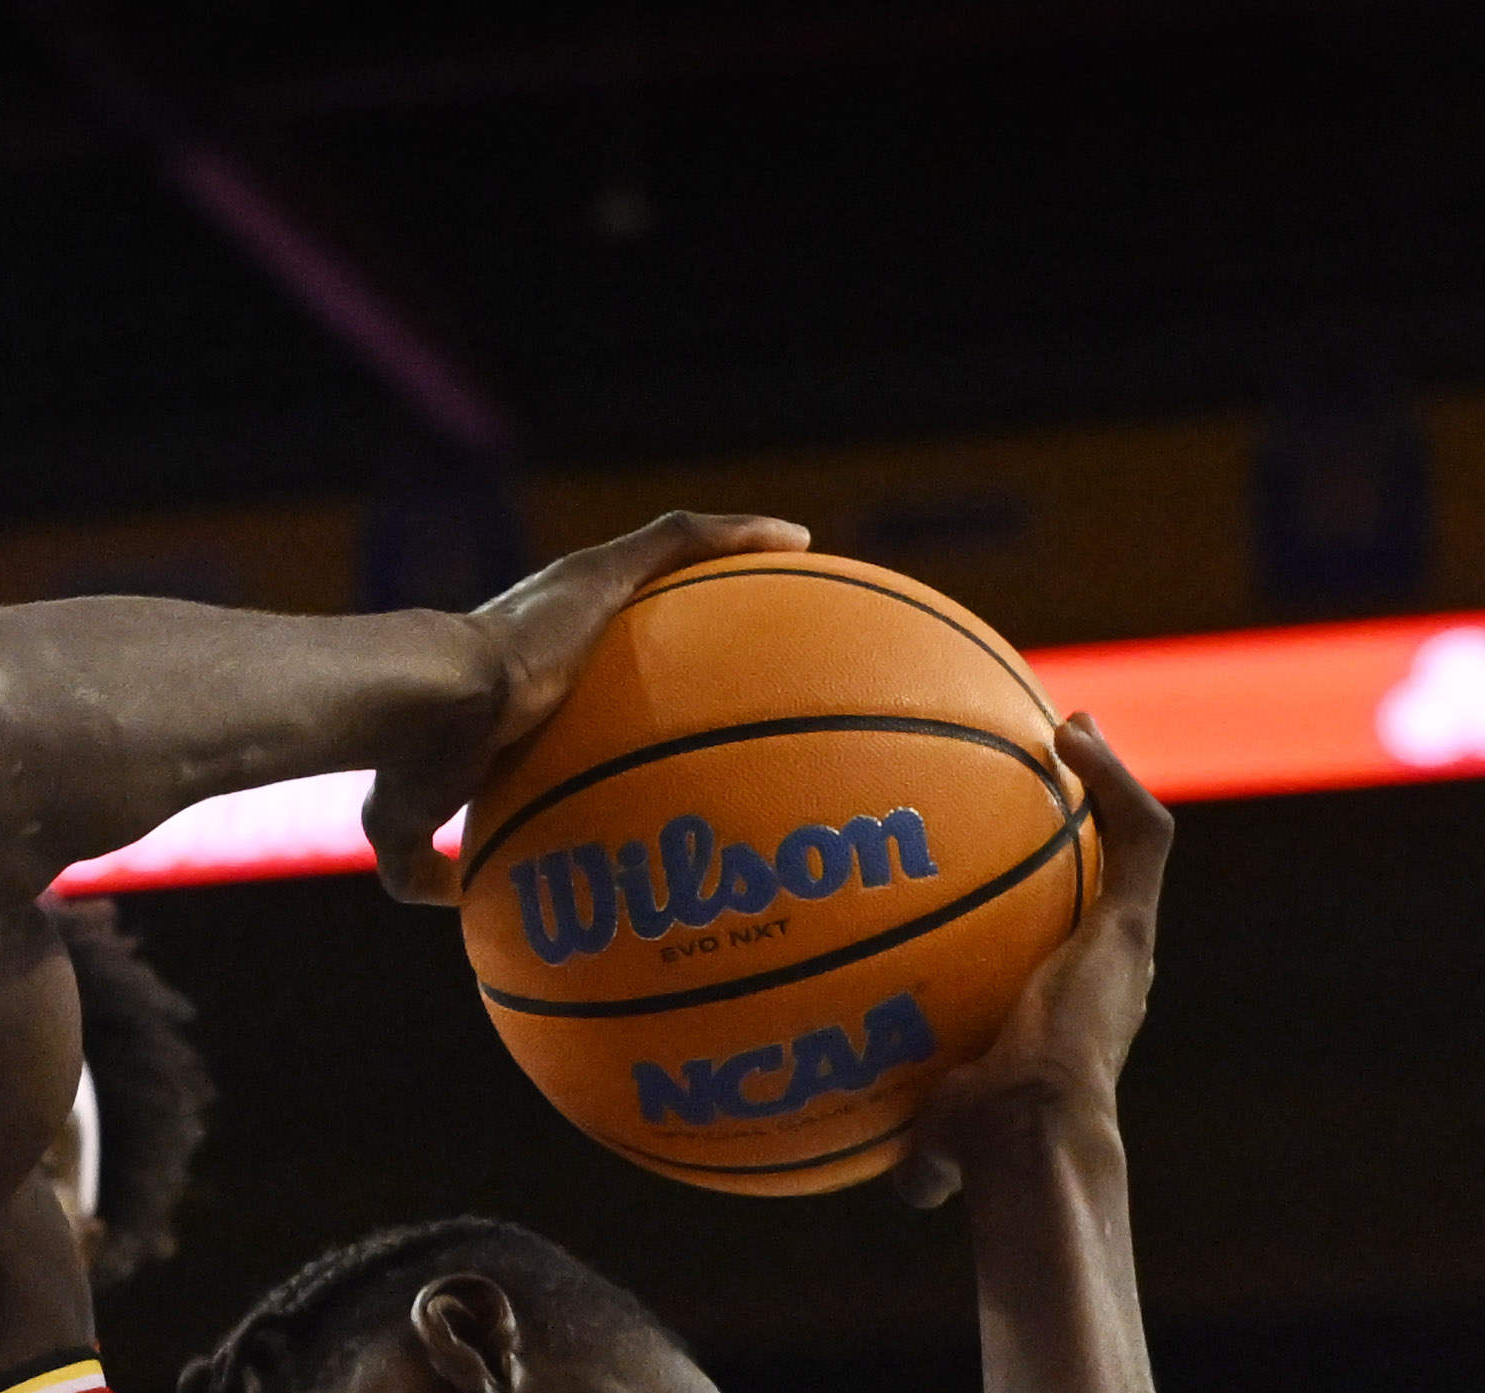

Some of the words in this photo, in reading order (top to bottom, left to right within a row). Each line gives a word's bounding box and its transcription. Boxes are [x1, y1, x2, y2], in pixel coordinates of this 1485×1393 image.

[509, 806, 939, 967] Wilson
[658, 935, 719, 965] EVO
[728, 918, 792, 949] NXT
[631, 991, 940, 1127] NCAA
